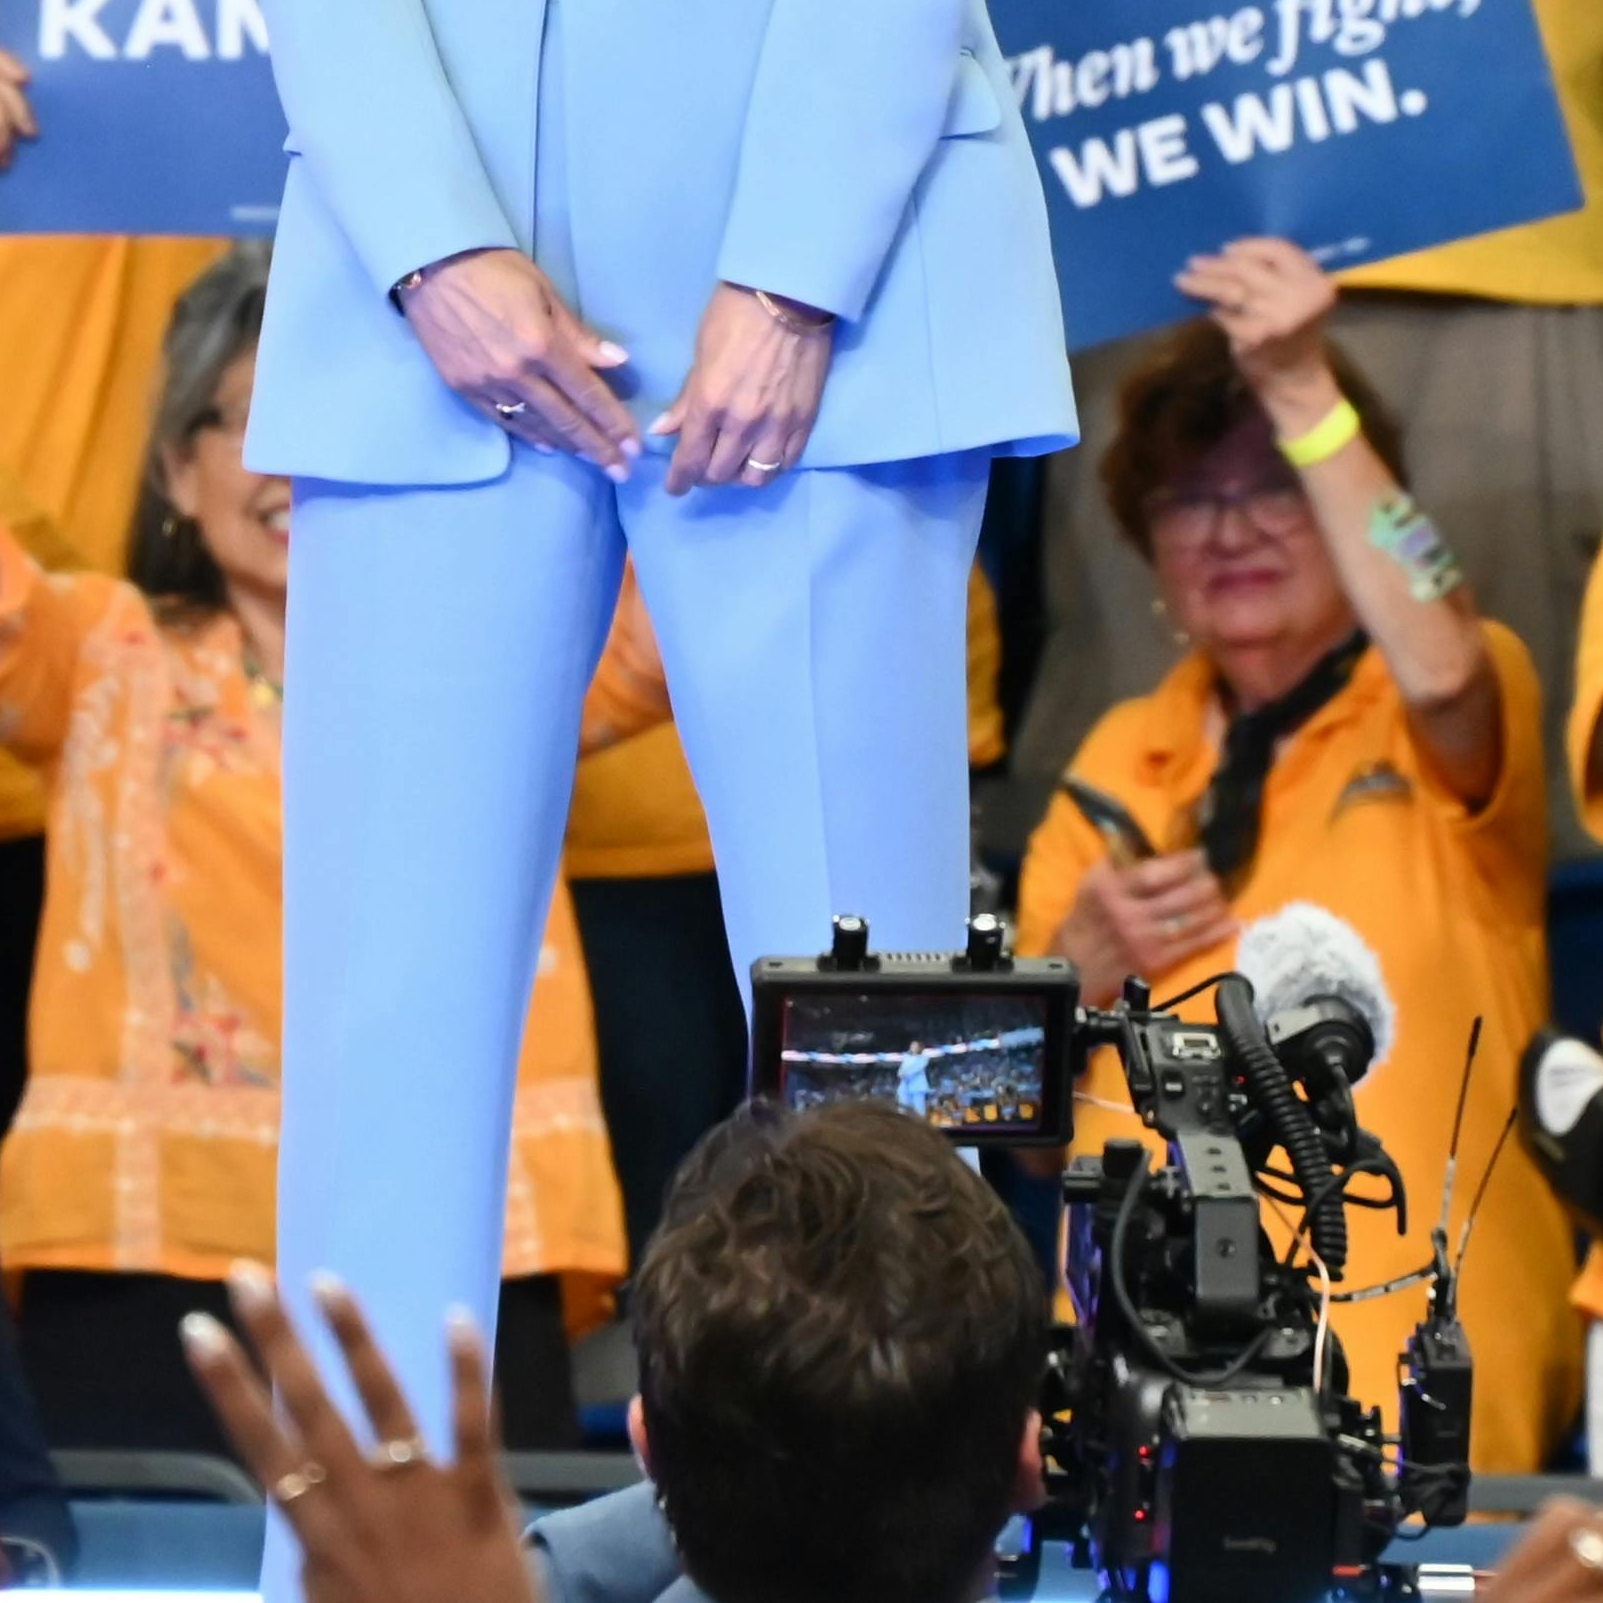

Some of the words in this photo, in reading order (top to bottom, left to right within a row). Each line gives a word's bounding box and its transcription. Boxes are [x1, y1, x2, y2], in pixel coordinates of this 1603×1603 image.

[1164, 6, 1266, 82] we
[1049, 112, 1200, 210] WE
[1201, 56, 1430, 164] WIN.
